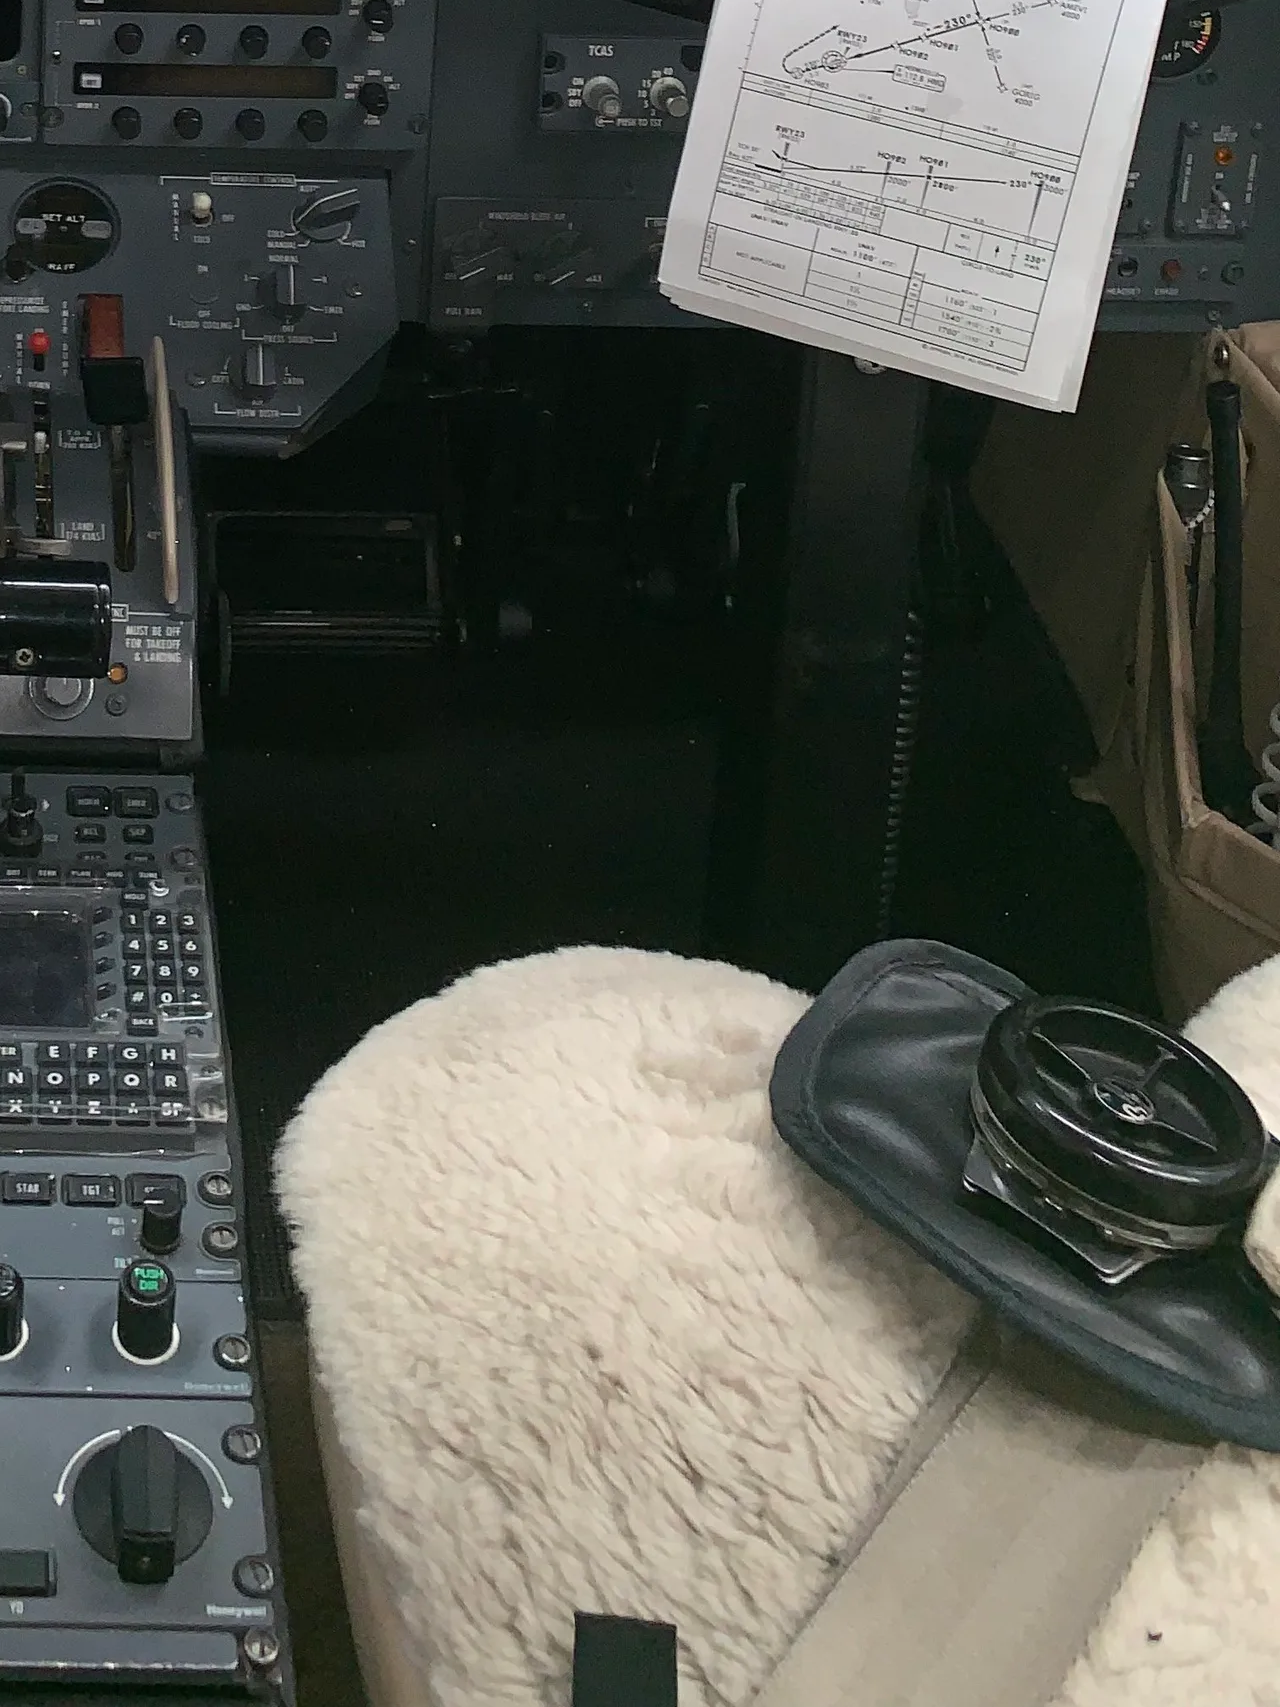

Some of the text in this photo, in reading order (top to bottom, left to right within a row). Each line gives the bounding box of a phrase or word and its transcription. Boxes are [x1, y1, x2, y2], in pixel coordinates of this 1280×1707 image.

[588, 44, 614, 57] TCAS
[642, 79, 652, 89] 15
[643, 99, 650, 109] 5
[775, 125, 806, 138] RWY23
[40, 213, 85, 223] SET ALT
[47, 263, 76, 271] RATE
[71, 522, 95, 531] LAND
[125, 625, 181, 637] MUST BE OFF
[125, 637, 181, 650] FOR TAKEOFF
[143, 651, 182, 663] LANDING
[128, 913, 138, 925] 1
[155, 914, 167, 926] 2
[182, 914, 194, 926] 3
[129, 939, 141, 951] 4
[158, 939, 169, 951] 5
[185, 940, 197, 951] 6
[130, 965, 142, 977] 7
[159, 965, 171, 977] 8
[187, 965, 199, 978] 9
[160, 992, 173, 1005] 0
[48, 1045, 60, 1058] E
[87, 1046, 98, 1059] F
[122, 1047, 139, 1060] G
[161, 1048, 176, 1061] H
[8, 1071, 24, 1085] N
[48, 1072, 64, 1085] O
[88, 1073, 101, 1086] P
[124, 1074, 140, 1087] Q
[164, 1075, 179, 1088] R
[82, 1185, 100, 1196] TGT
